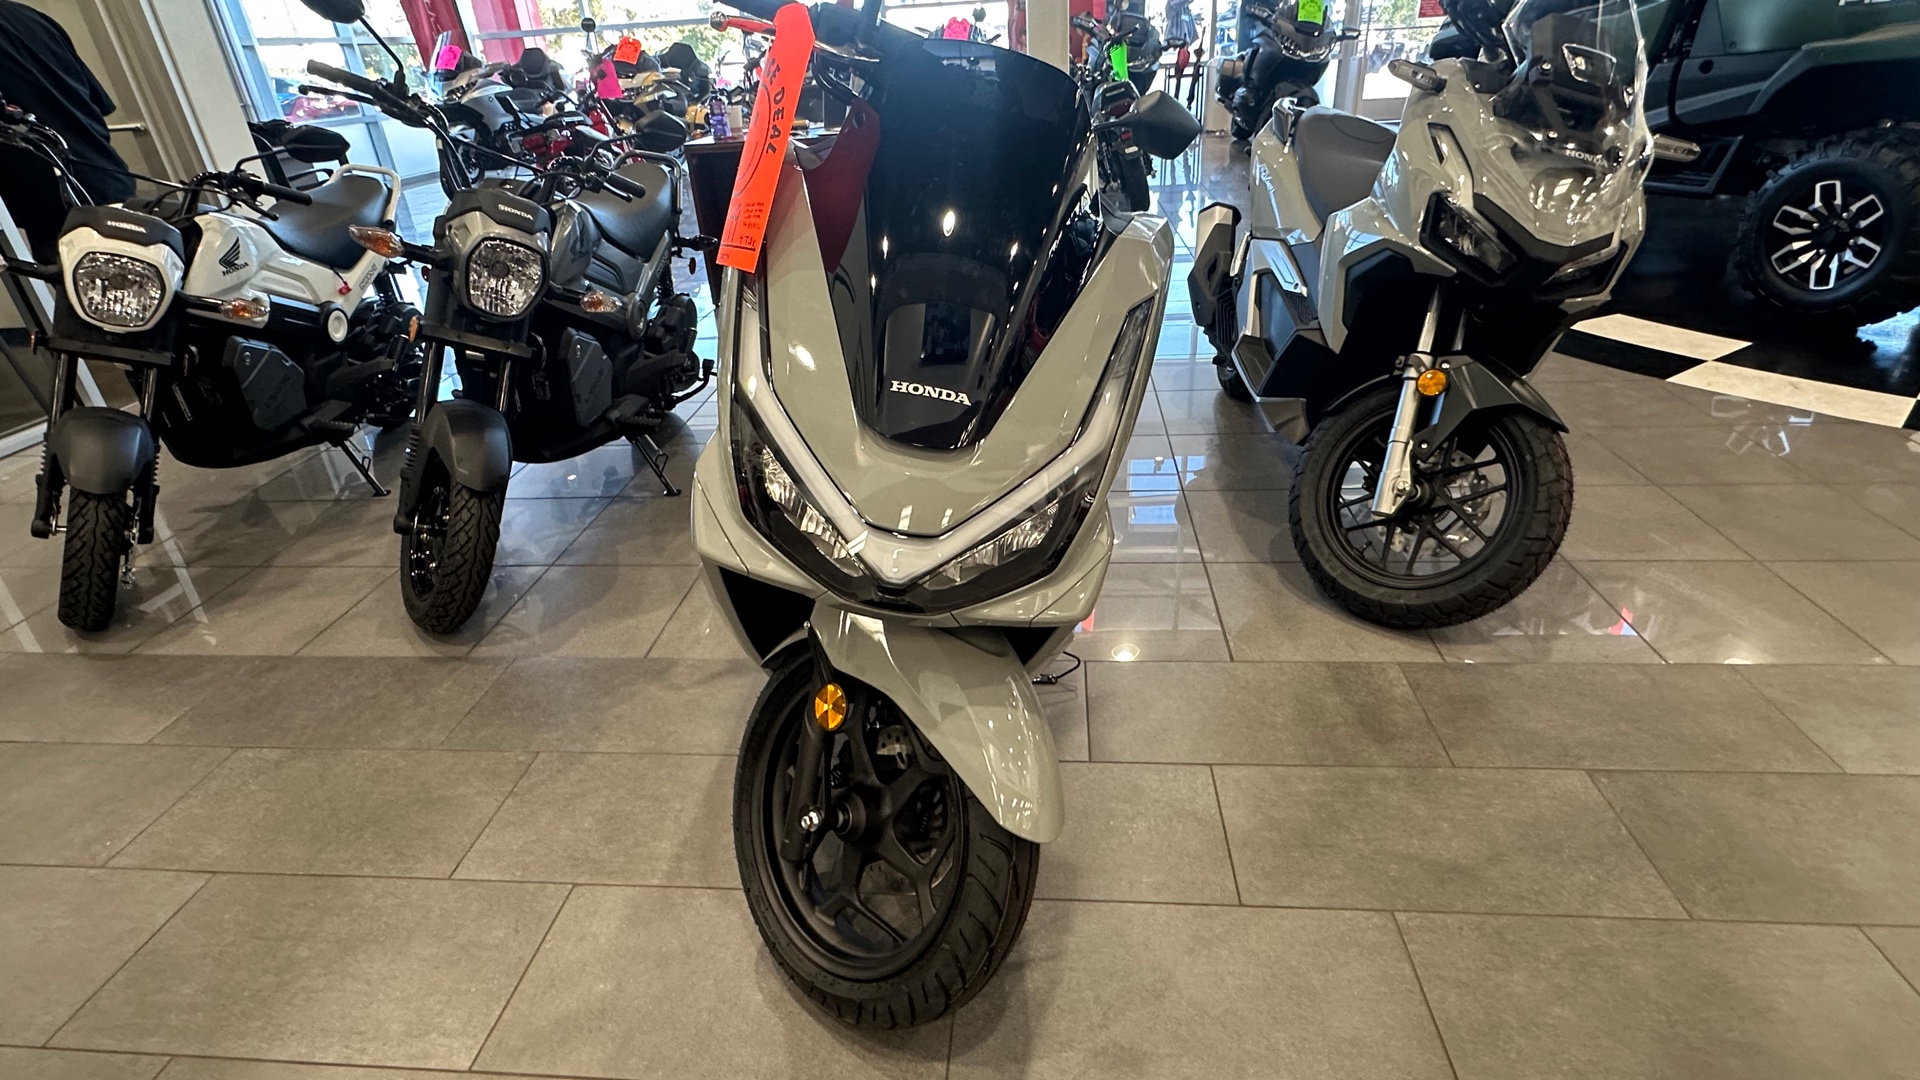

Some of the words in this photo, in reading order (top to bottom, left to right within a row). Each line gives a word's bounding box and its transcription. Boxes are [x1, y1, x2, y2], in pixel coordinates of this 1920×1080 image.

[766, 86, 785, 155] DEAL
[1565, 149, 1608, 169] HONDA
[498, 203, 534, 221] HONDA
[106, 220, 147, 234] HONDA
[222, 261, 250, 277] HONDA
[889, 380, 972, 406] HONDA
